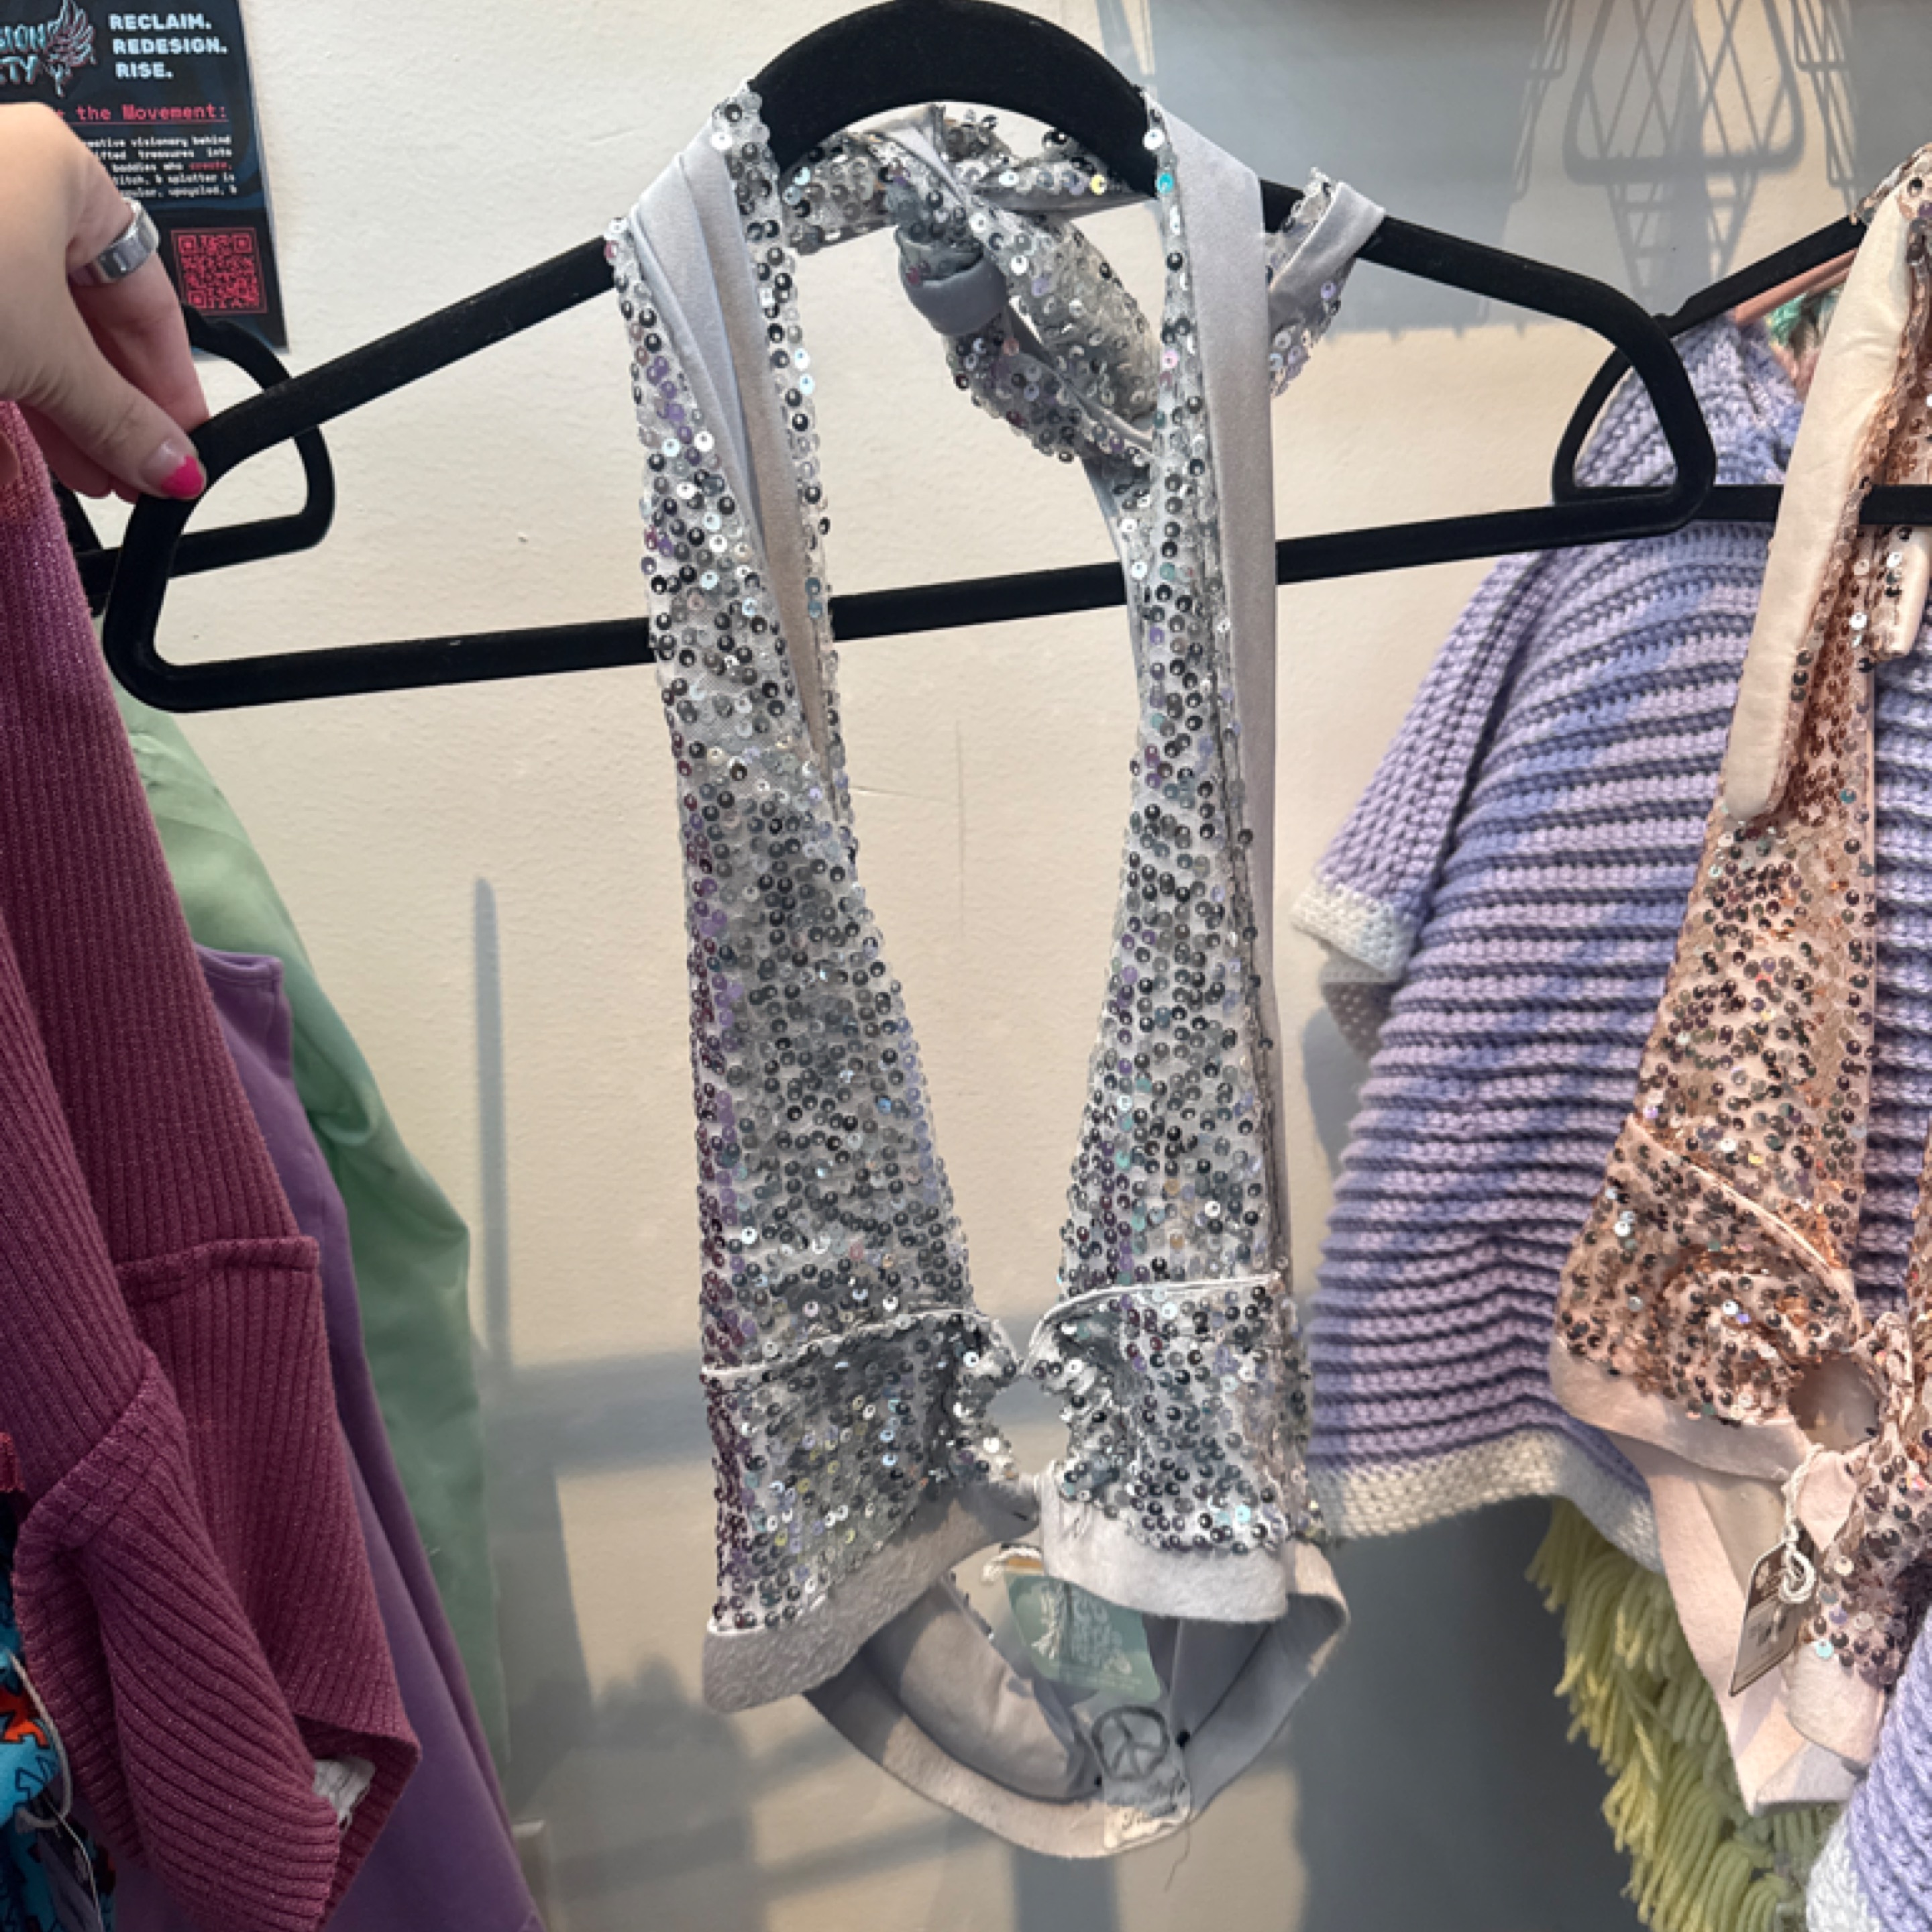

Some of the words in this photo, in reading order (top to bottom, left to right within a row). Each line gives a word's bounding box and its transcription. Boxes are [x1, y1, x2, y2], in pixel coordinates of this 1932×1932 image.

[109, 13, 211, 31] RECLAIM.
[113, 38, 227, 54] REDESIGN.
[115, 62, 174, 79] RISE.
[76, 104, 111, 120] the
[121, 103, 227, 120] Movement:
